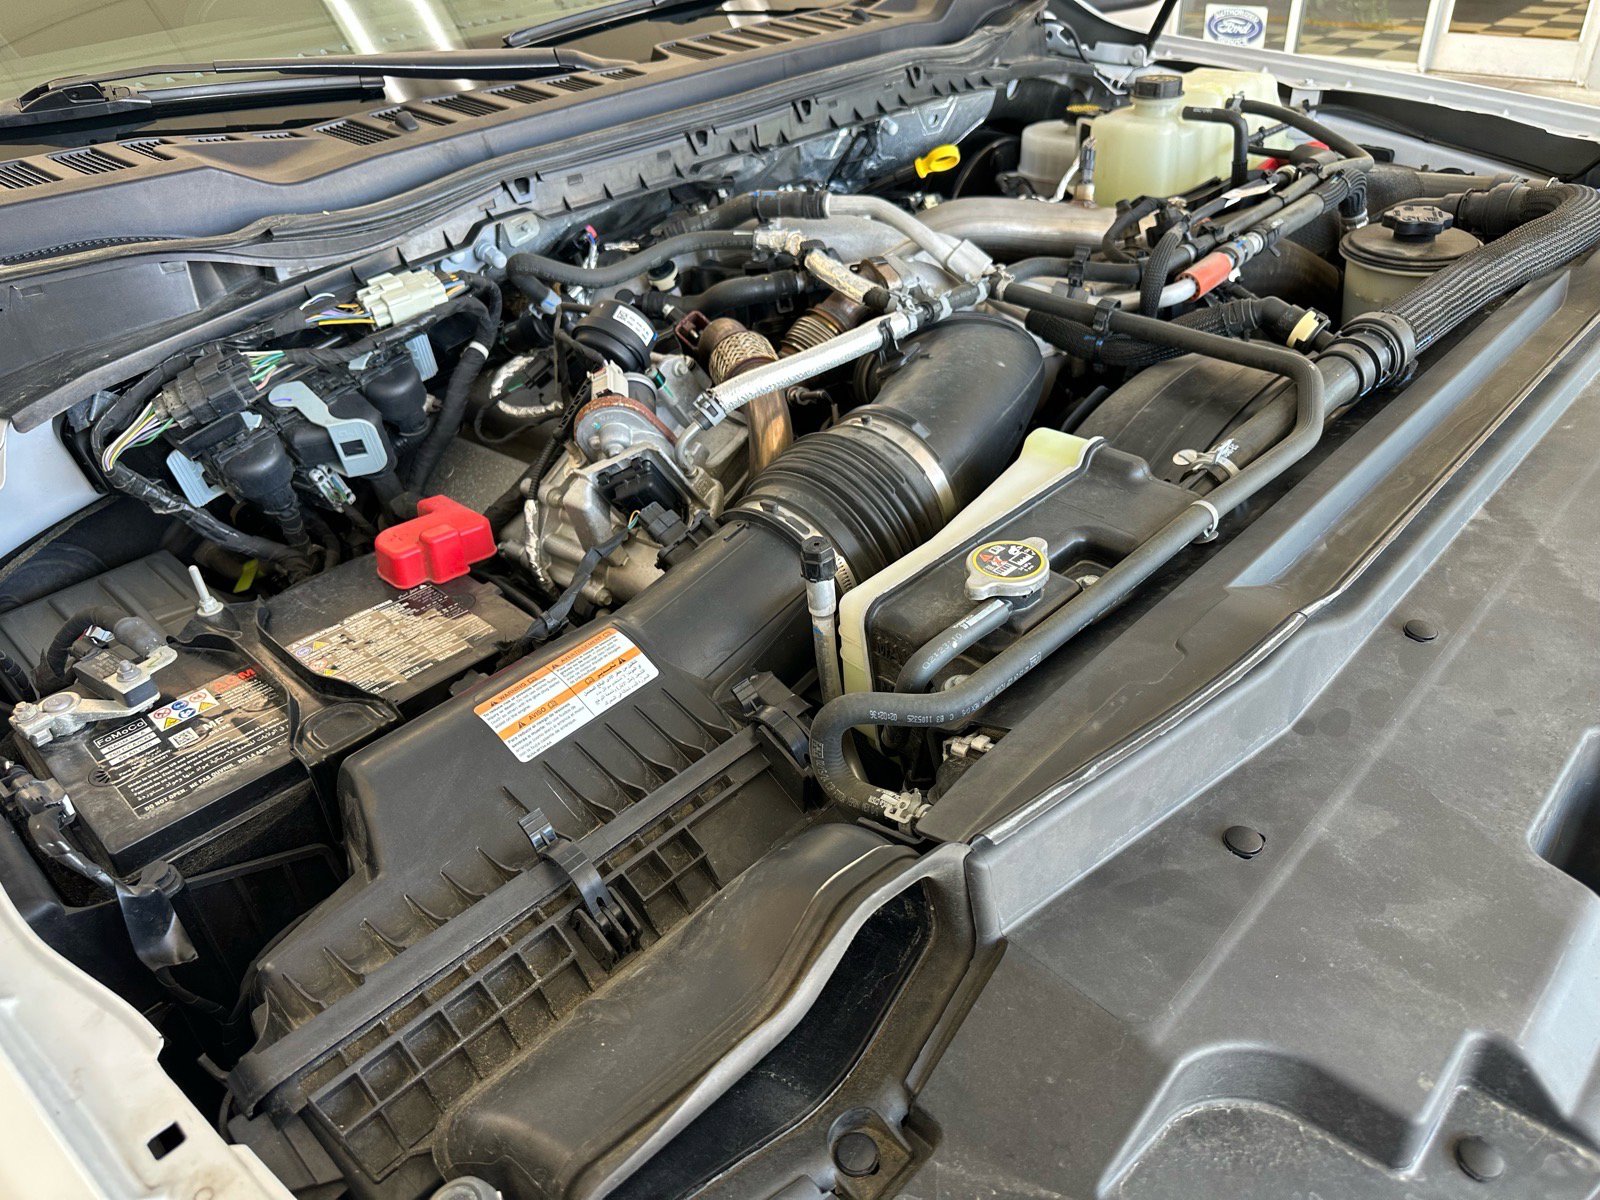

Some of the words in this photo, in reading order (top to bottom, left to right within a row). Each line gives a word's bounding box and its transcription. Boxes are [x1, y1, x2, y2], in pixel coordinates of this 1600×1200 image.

[1216, 18, 1252, 35] Ford
[498, 681, 527, 700] WARNING
[526, 706, 547, 720] AVISO
[202, 716, 225, 731] MF
[94, 720, 146, 746] FoMoCo
[143, 803, 154, 811] DO
[154, 796, 168, 805] NOT
[167, 787, 188, 799] OPEN.
[197, 775, 211, 783] PAS
